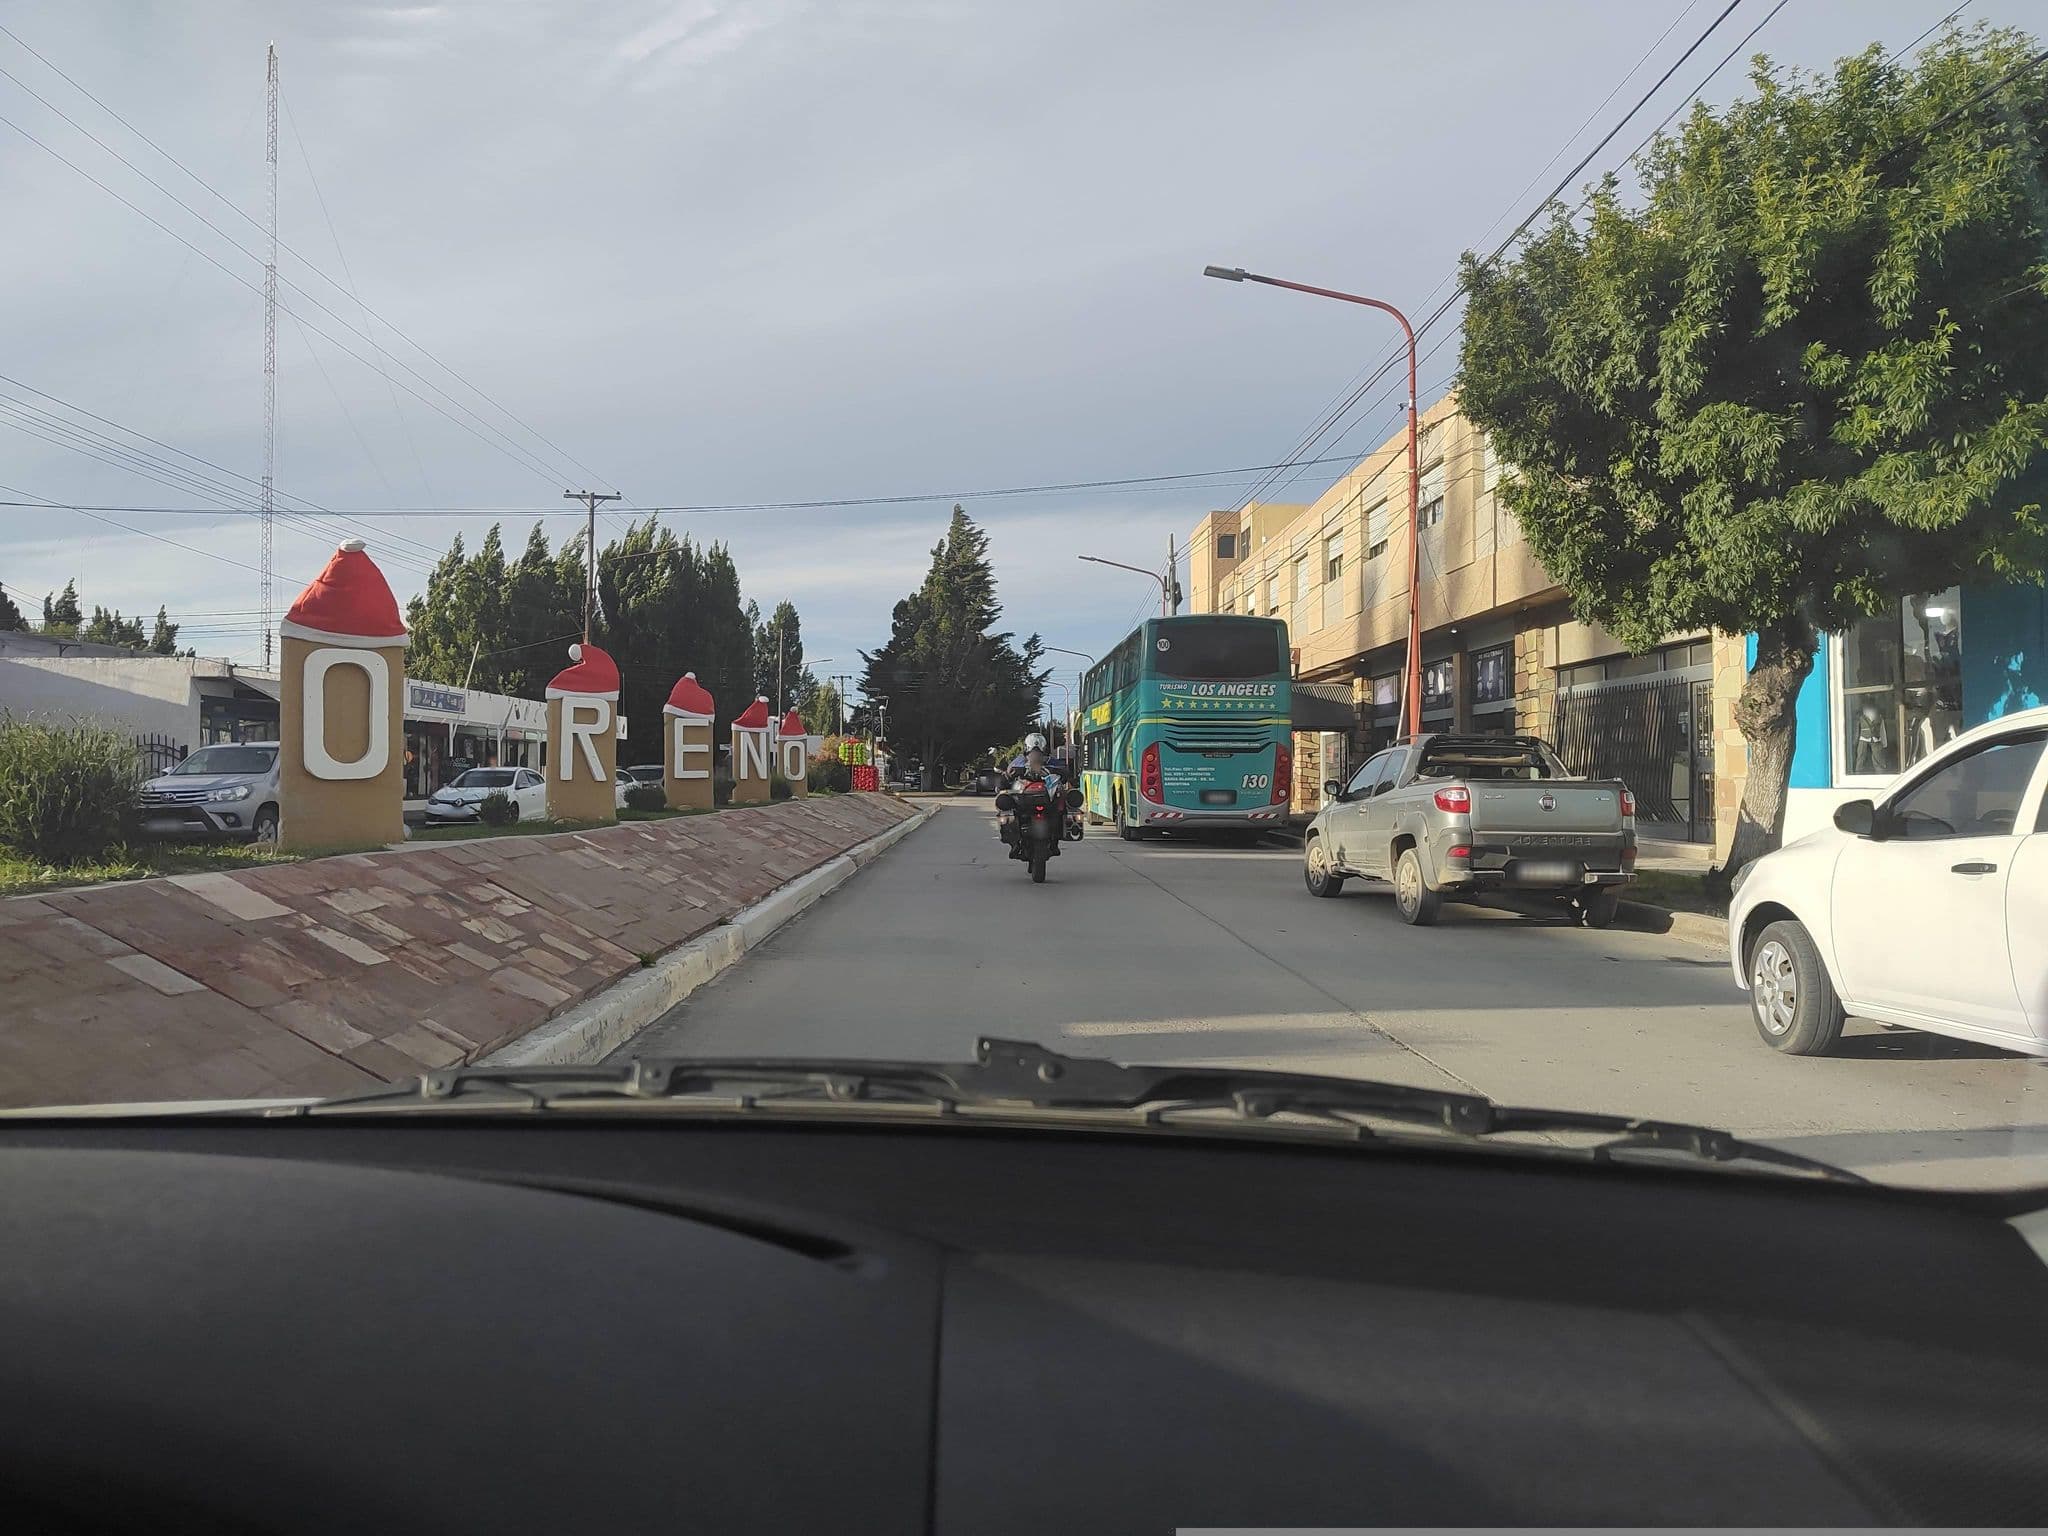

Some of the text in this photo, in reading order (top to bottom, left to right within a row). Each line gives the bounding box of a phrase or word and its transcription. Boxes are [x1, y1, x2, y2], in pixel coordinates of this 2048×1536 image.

[1159, 683, 1277, 696] TURISMO LOS ANGELES
[1241, 774, 1269, 789] 130
[1511, 836, 1592, 846] ADVENTURE
